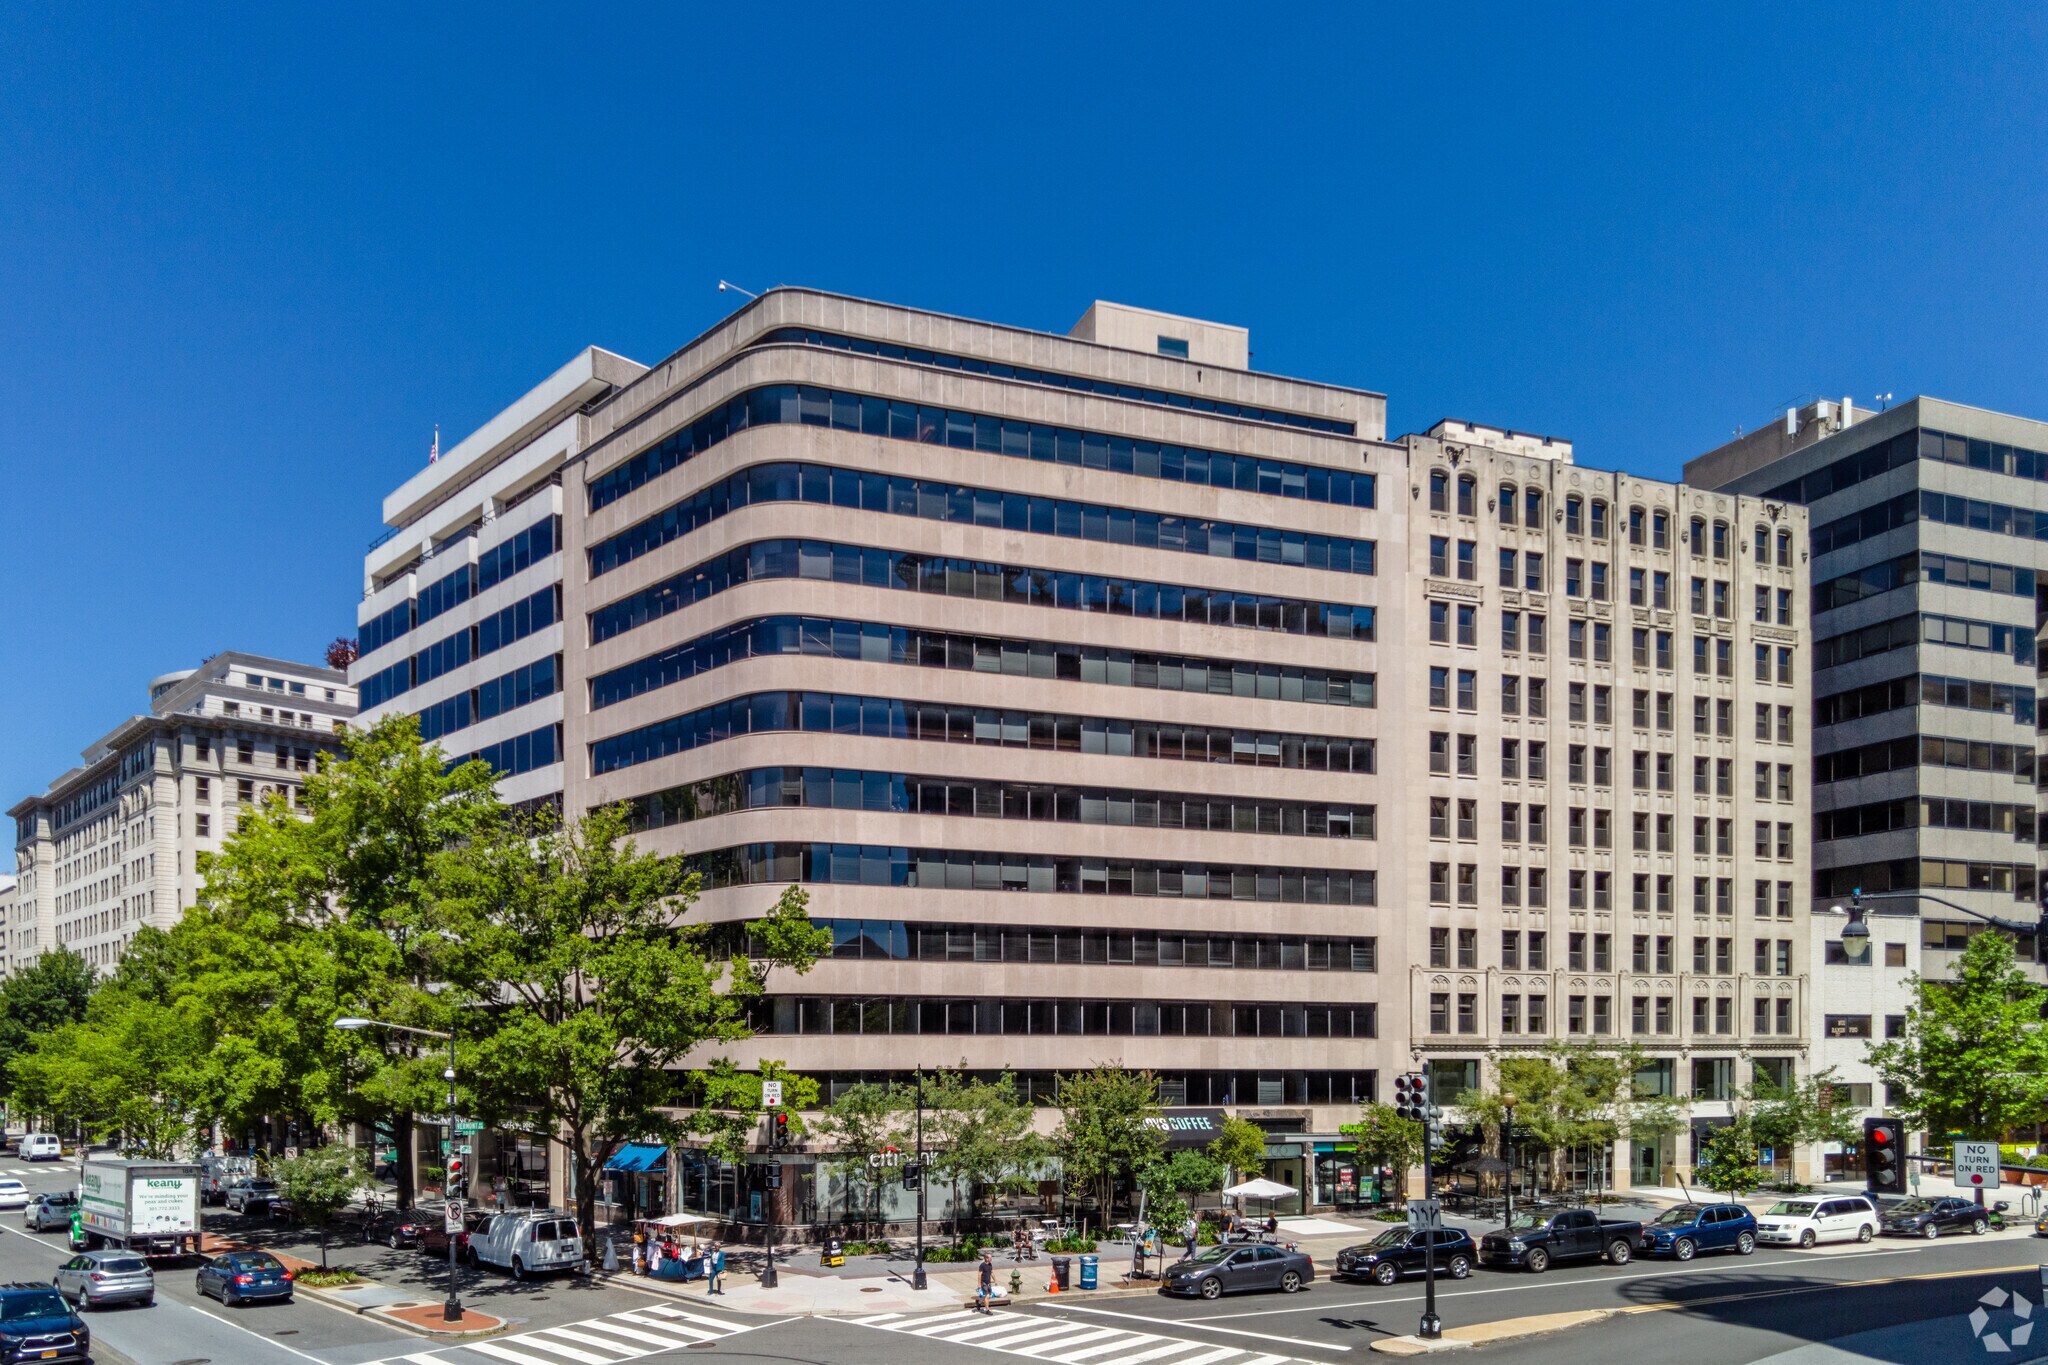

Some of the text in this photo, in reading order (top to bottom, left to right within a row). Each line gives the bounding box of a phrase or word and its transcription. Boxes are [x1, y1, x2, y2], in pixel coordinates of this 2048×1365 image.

[1168, 1117, 1213, 1130] COFFEE
[1967, 1145, 1986, 1154] NO
[868, 1147, 939, 1167] citink
[147, 1178, 182, 1189] keany
